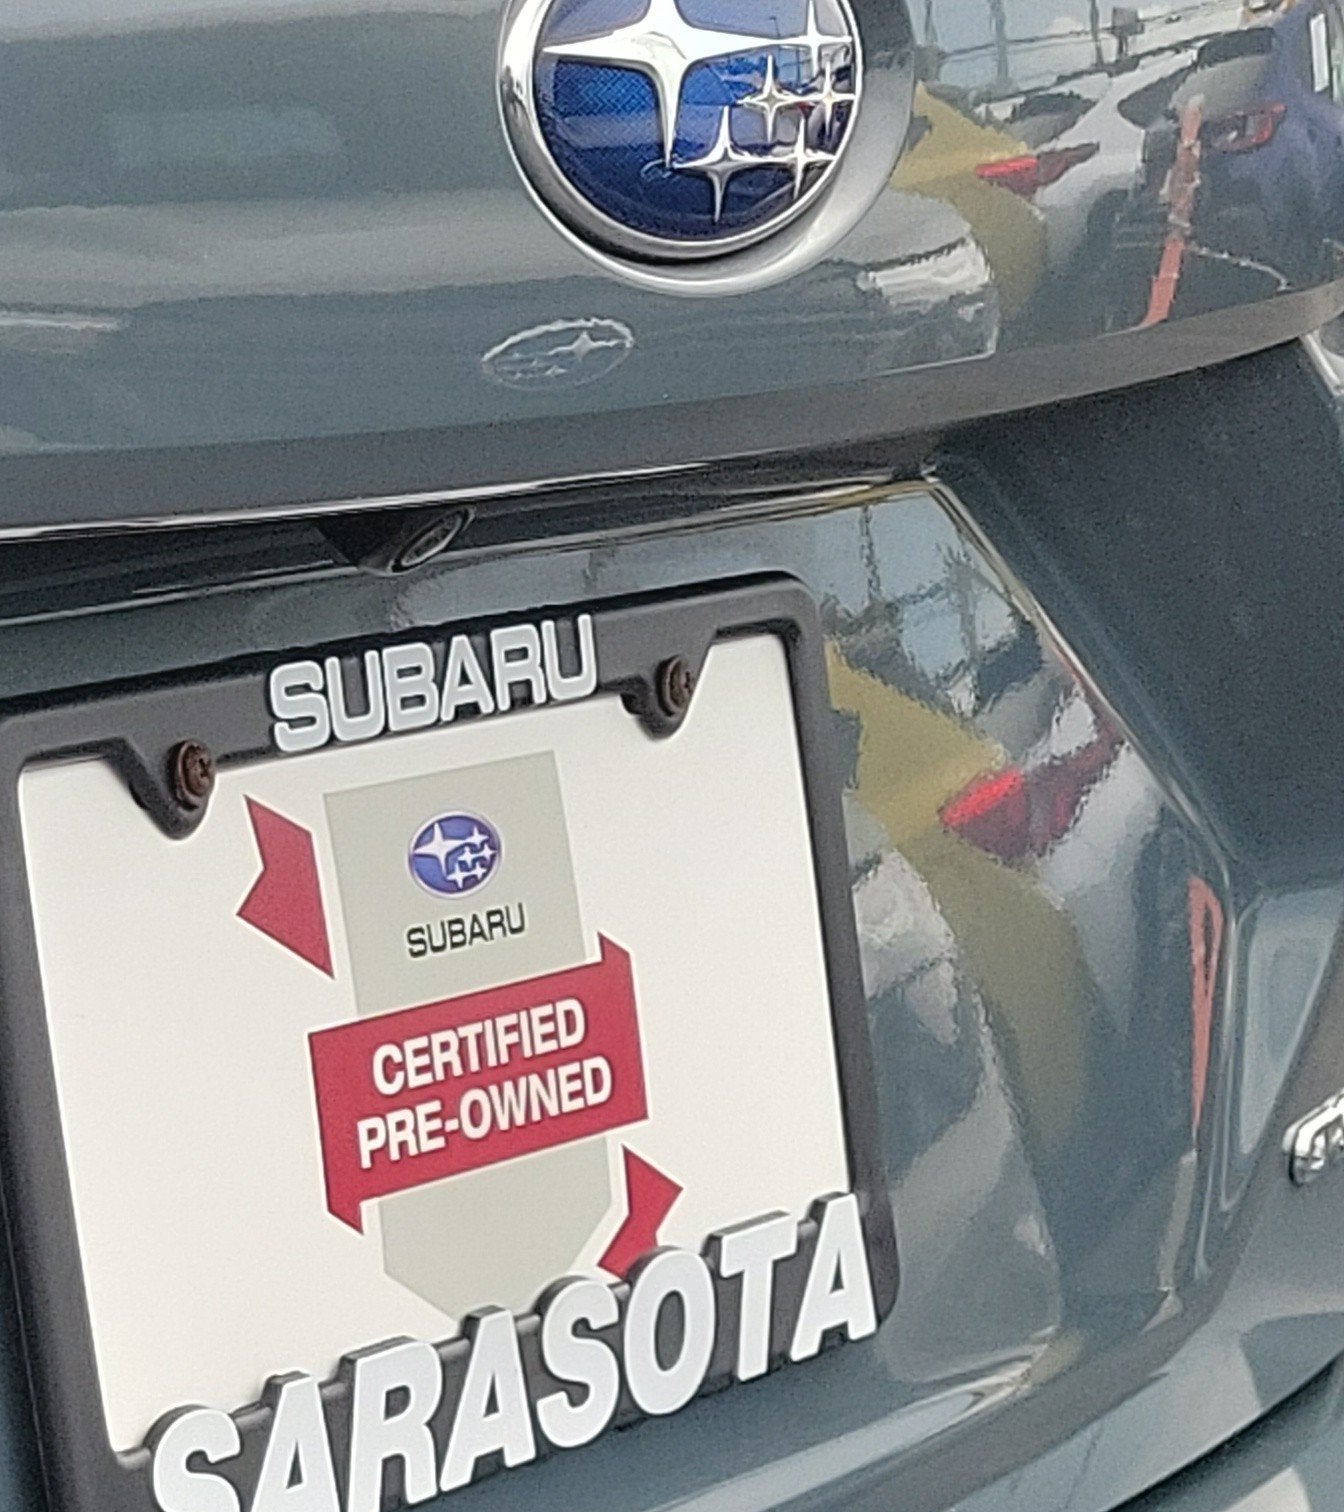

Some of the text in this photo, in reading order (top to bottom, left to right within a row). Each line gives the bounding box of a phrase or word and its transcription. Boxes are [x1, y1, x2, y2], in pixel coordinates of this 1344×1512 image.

[269, 614, 598, 752] SUBARU
[406, 902, 526, 959] SUBARU
[371, 998, 586, 1097] CERTIFIED
[357, 1054, 612, 1169] PRE-OWNED
